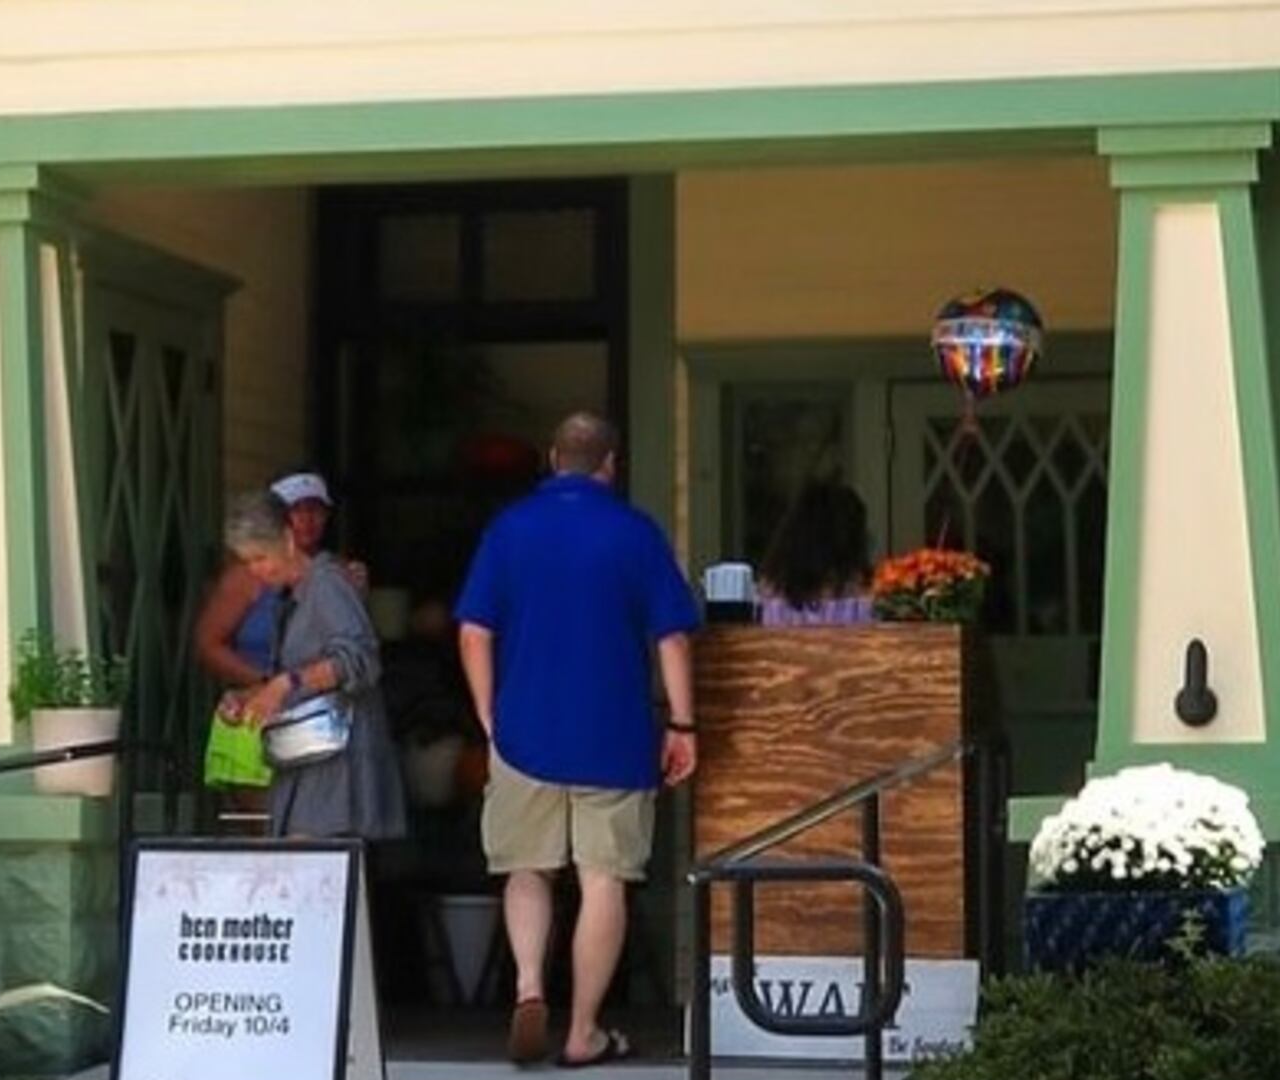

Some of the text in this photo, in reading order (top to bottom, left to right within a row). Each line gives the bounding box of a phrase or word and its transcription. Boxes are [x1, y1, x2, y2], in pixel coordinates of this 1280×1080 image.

[180, 911, 294, 940] hen mother
[178, 942, 290, 963] COOKHOUSE
[174, 992, 282, 1013] OPENING
[758, 979, 911, 1029] WA
[168, 1014, 290, 1039] Friday 10/4
